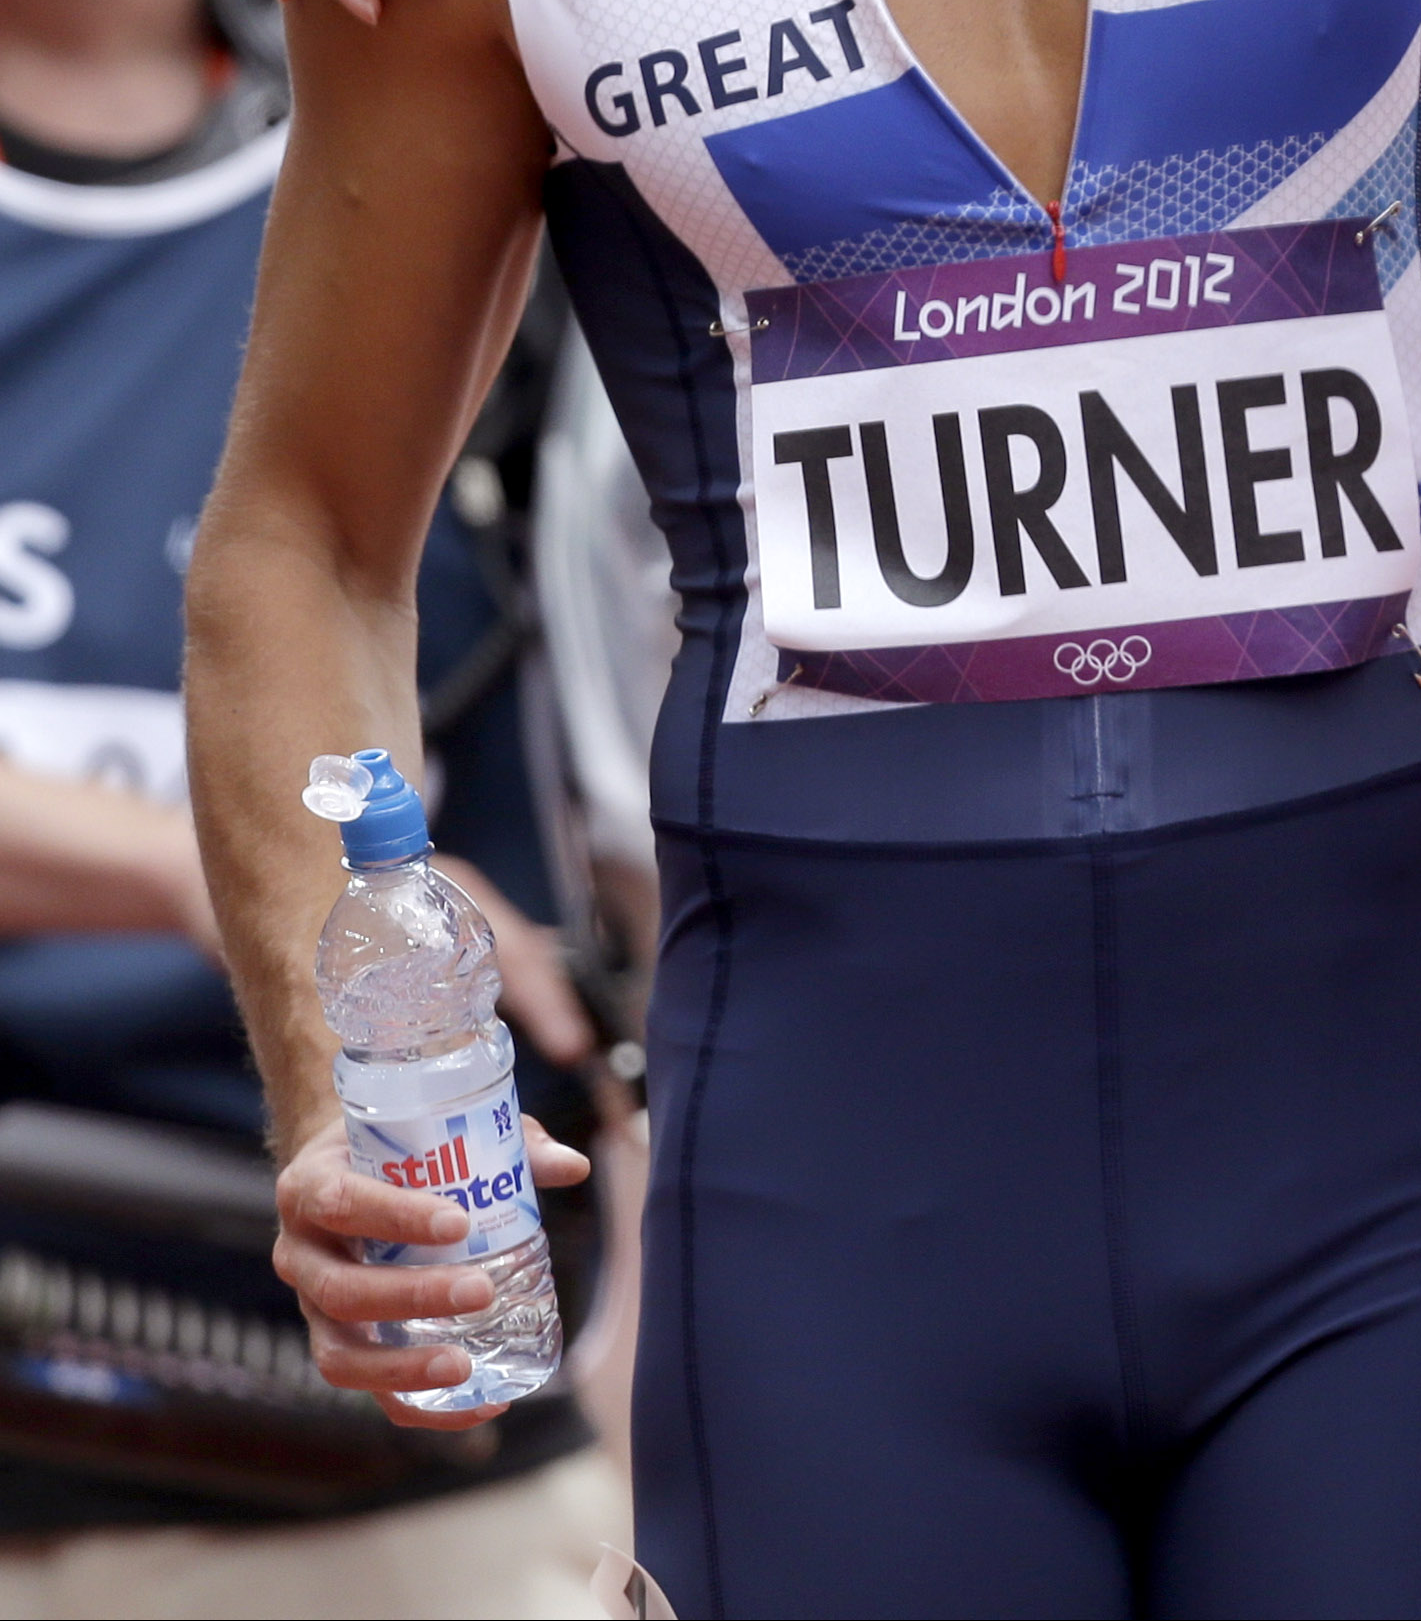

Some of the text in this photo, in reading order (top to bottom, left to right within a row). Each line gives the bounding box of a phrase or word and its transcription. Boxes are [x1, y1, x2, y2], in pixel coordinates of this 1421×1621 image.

[893, 252, 1235, 341] London 2012
[773, 366, 1404, 611] TURNER
[382, 1134, 470, 1188] still
[432, 1160, 524, 1212] ater
